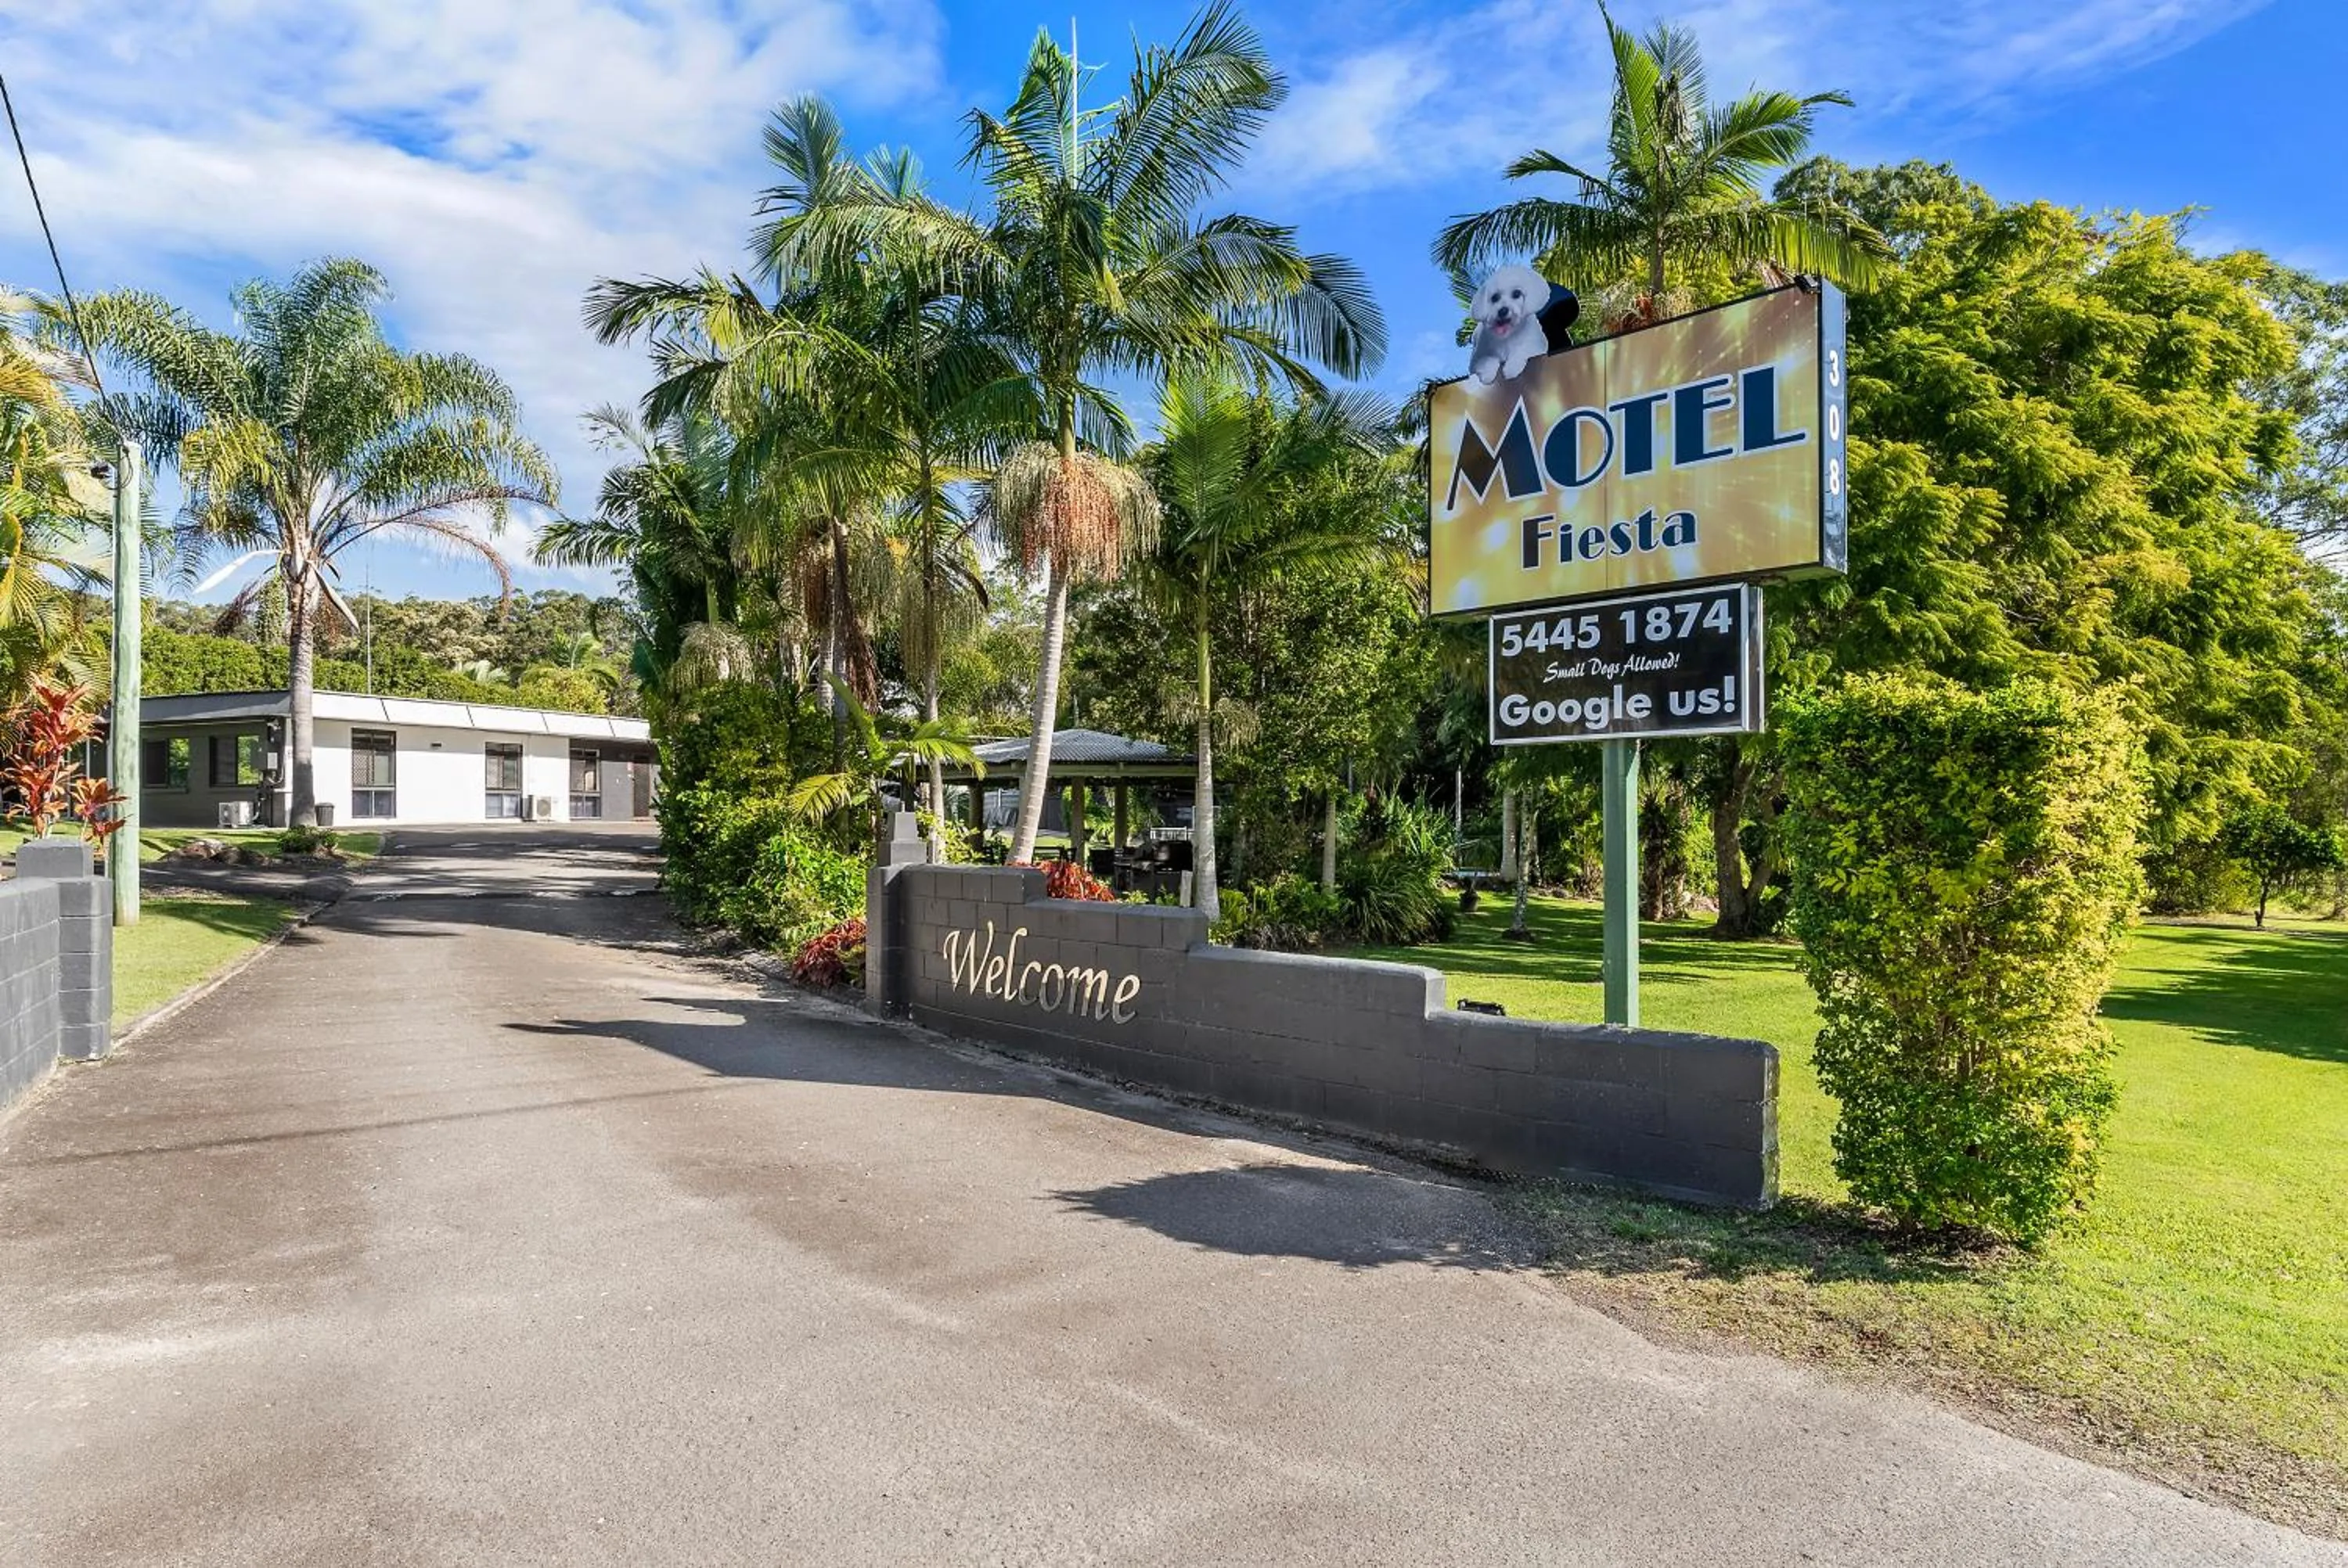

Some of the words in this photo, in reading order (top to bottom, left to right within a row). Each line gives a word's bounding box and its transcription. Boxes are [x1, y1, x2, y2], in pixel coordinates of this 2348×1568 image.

[1446, 364, 1809, 512] MOTEL
[1520, 504, 1698, 570] Fiesta
[1500, 614, 1601, 656] 5445
[1619, 599, 1733, 644] 1874
[1543, 660, 1585, 683] Small
[1587, 658, 1620, 680] Dogs
[1621, 652, 1681, 677] Allowed!
[1499, 685, 1652, 730] Google
[1669, 675, 1736, 716] us!
[942, 919, 1140, 1024] Welcome
